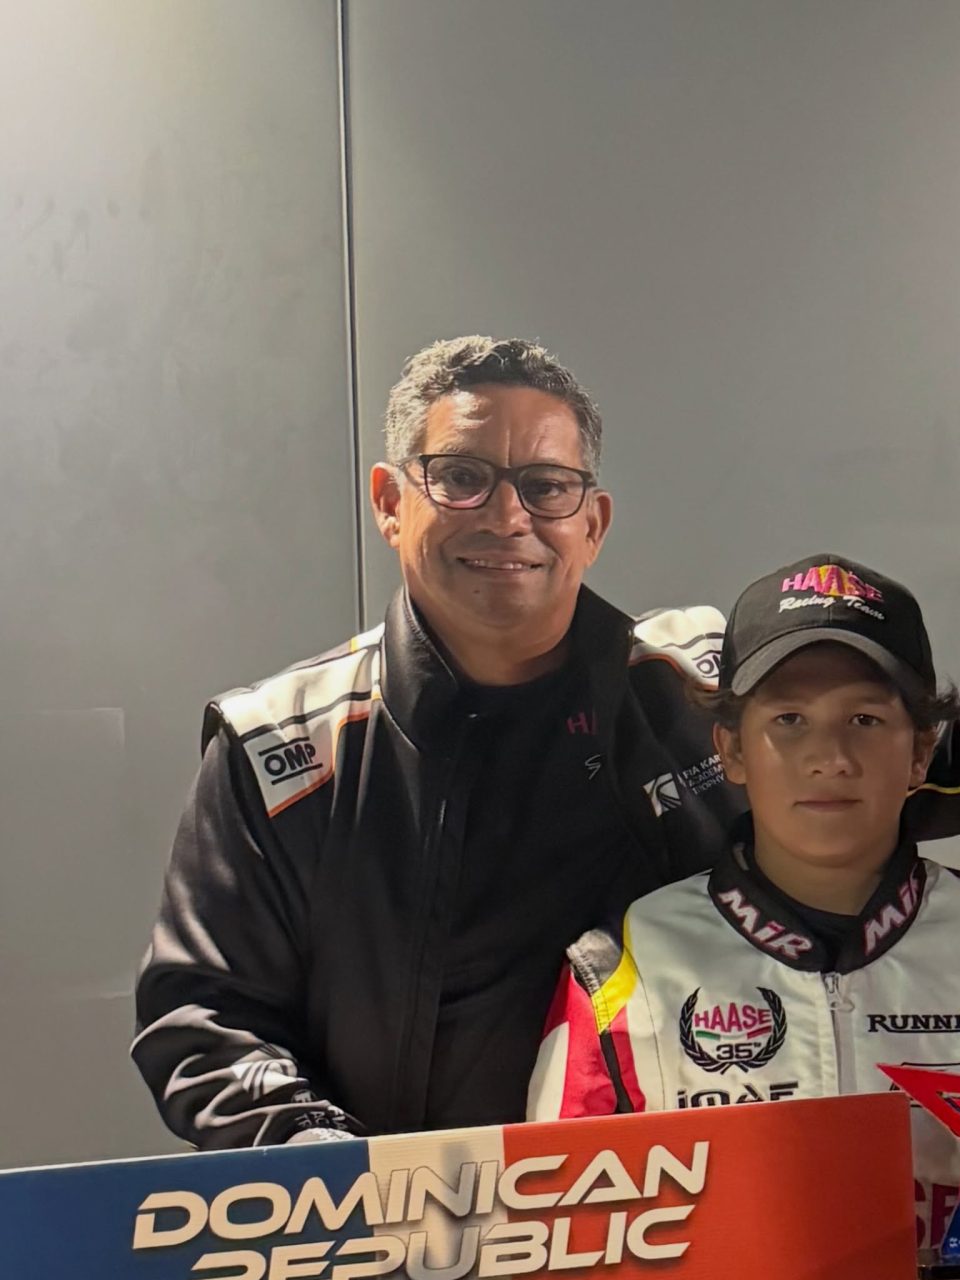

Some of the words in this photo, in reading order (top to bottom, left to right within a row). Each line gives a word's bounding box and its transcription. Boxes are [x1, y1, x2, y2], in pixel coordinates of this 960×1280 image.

[781, 564, 885, 603] HAASE
[779, 594, 837, 614] Racing
[842, 594, 885, 620] Team
[264, 742, 316, 776] OMP
[694, 1002, 773, 1033] HAASE
[132, 1141, 711, 1250] DOMINICAN
